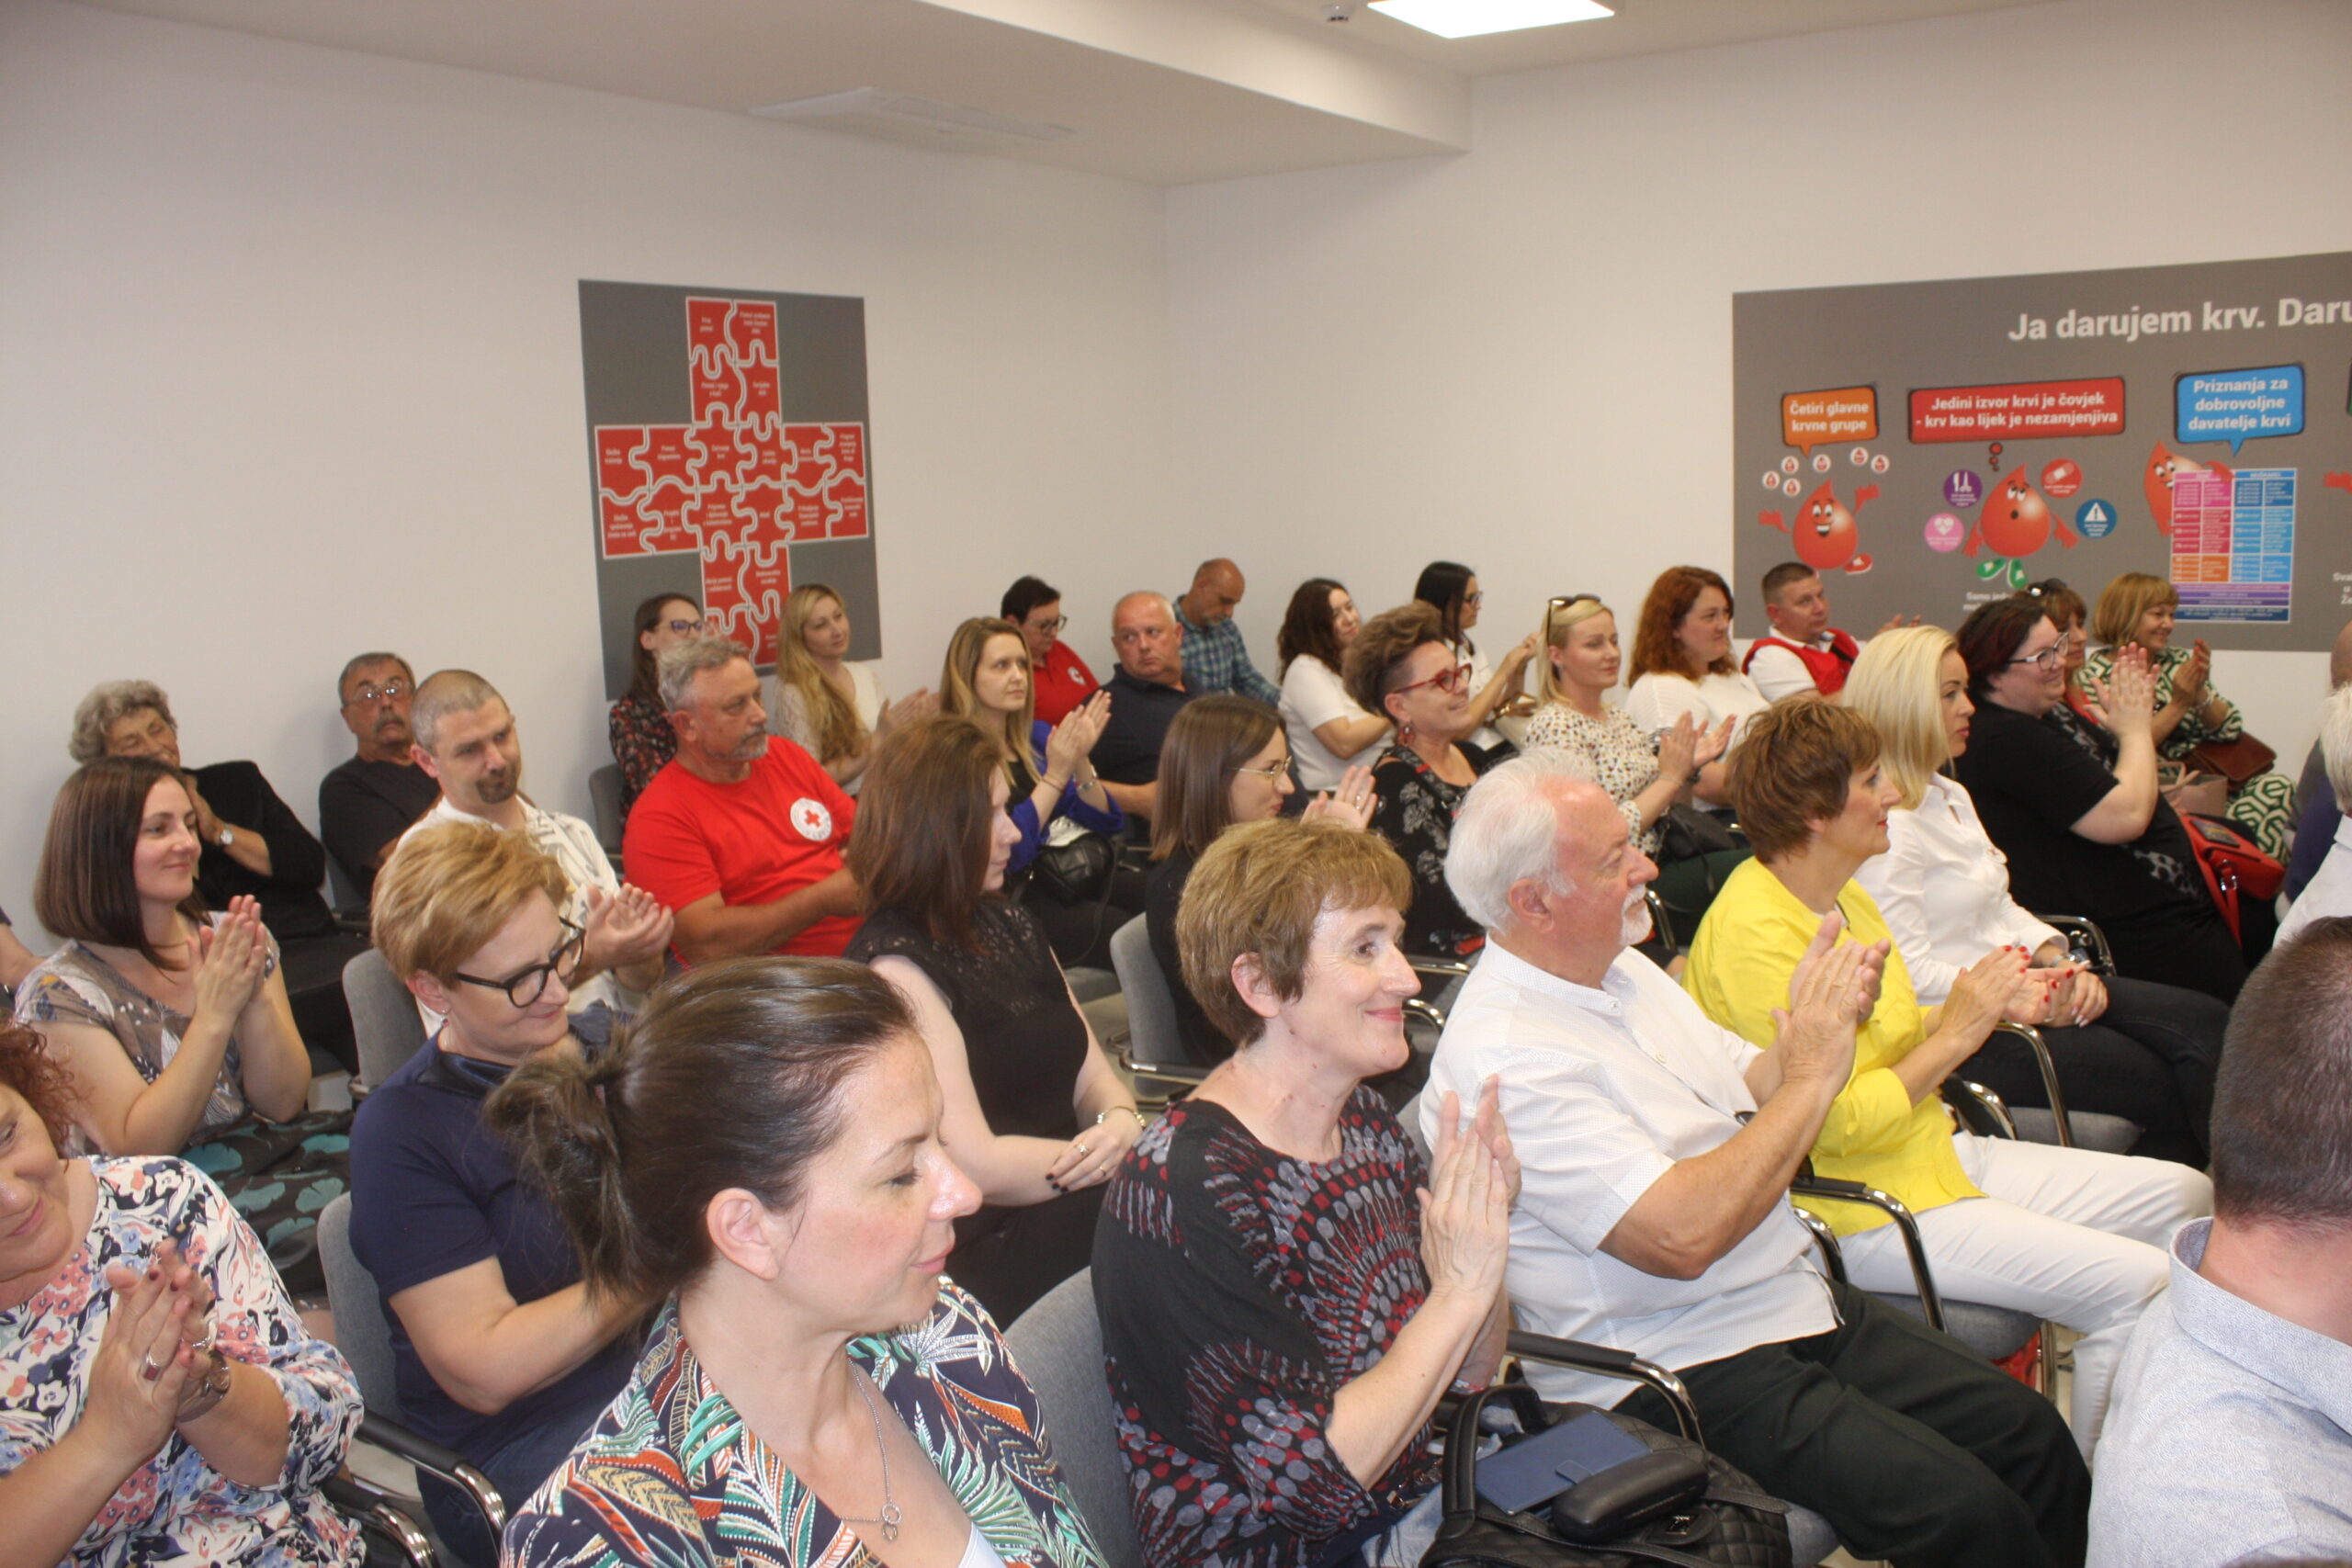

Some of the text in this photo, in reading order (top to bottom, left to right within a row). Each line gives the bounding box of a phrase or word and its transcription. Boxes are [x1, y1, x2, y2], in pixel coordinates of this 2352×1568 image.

[2007, 313, 2047, 341] Ja
[2055, 306, 2192, 343] darujem
[2201, 300, 2266, 331] krv.
[2194, 377, 2289, 394] Priznanja za
[1826, 400, 1870, 417] glavne
[1931, 391, 2105, 411] Jedini izvor krvi je čovjek
[2195, 395, 2286, 412] dobrovoljne
[1791, 419, 1868, 434] krvne grupe
[1925, 413, 1947, 428] krv
[1950, 412, 1974, 427] kao
[1977, 412, 2007, 428] lijek
[2008, 412, 2022, 429] je
[2025, 409, 2118, 427] nezamjenjiva
[2188, 412, 2292, 432] davatelje krvi
